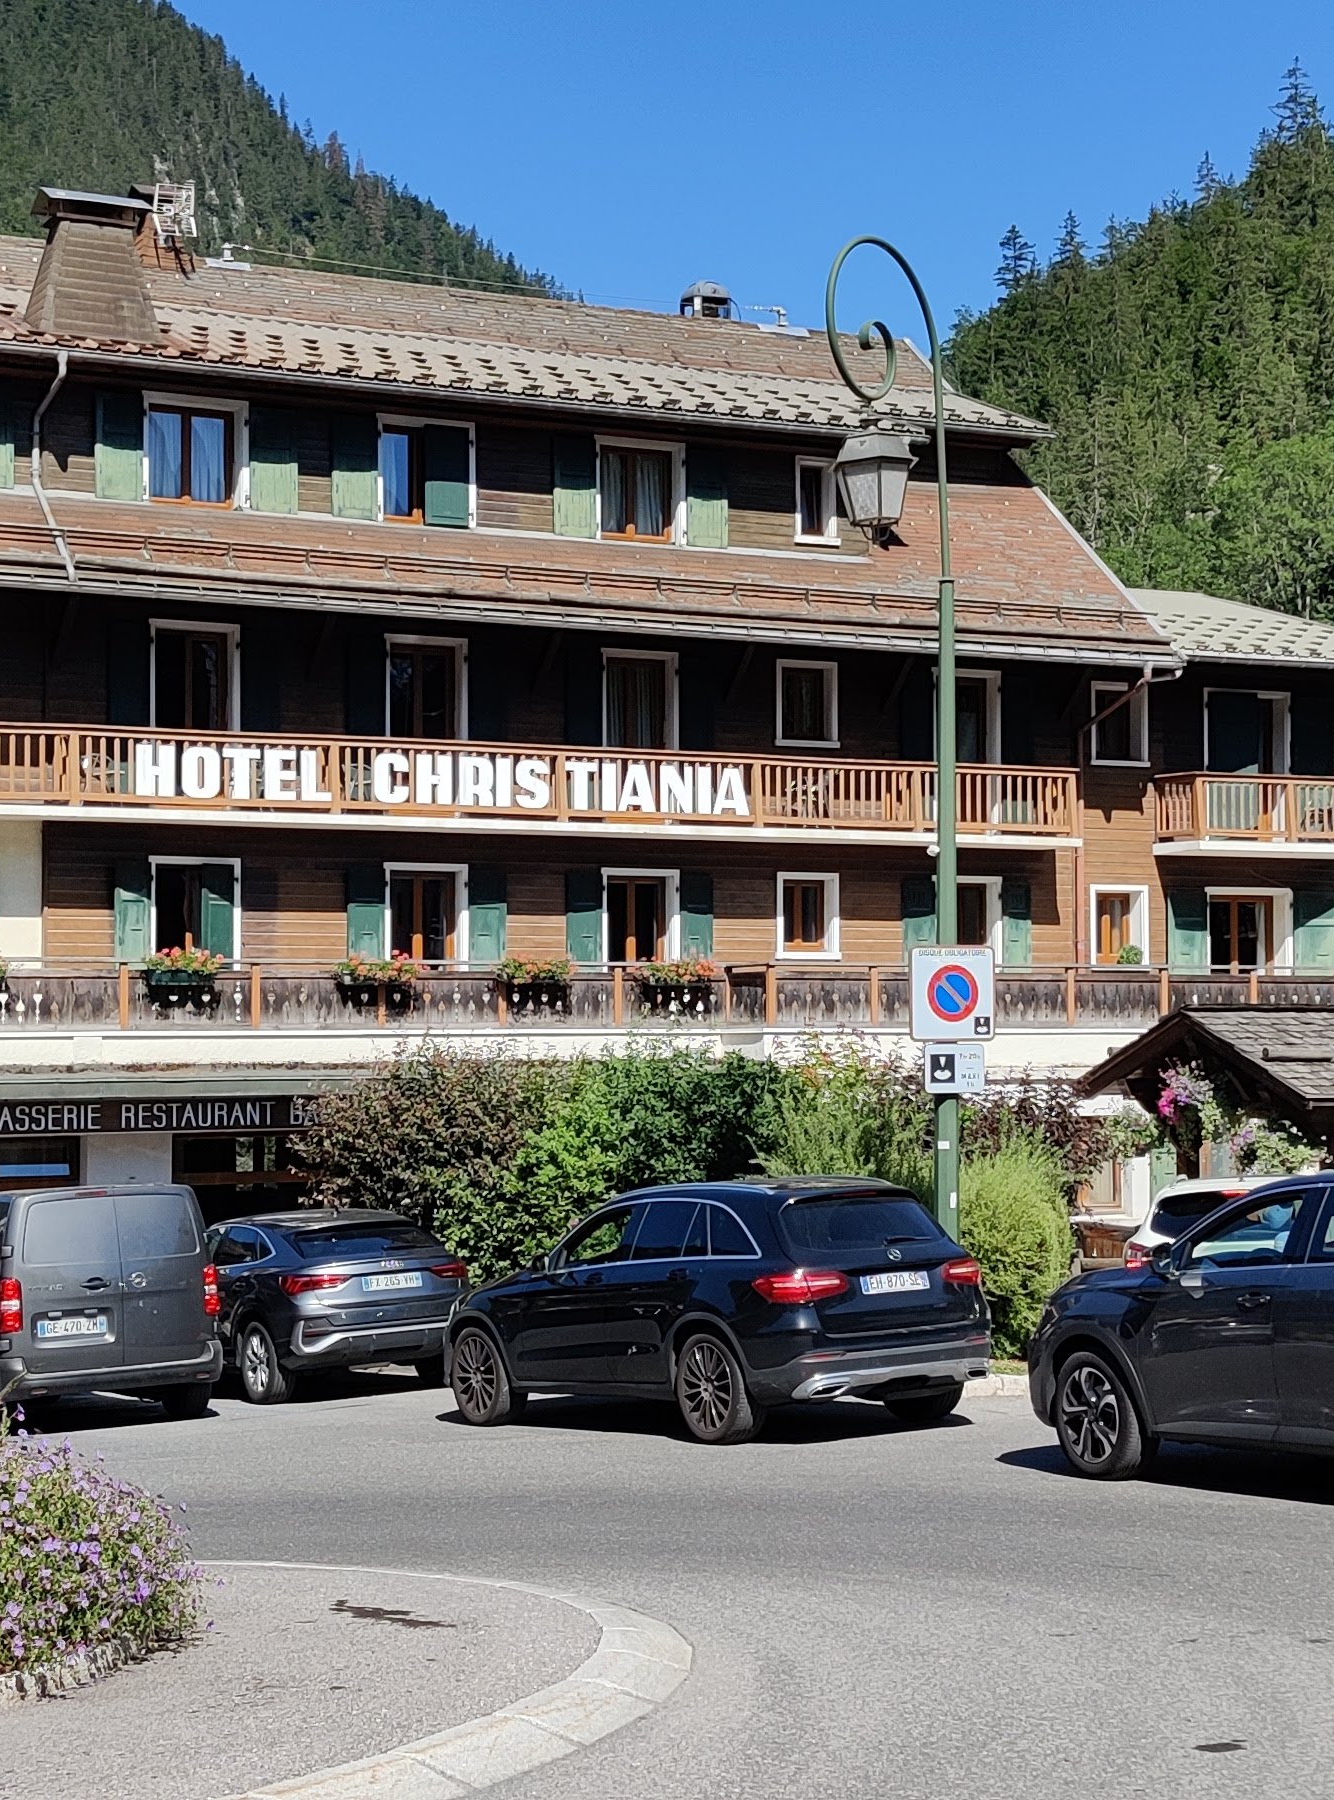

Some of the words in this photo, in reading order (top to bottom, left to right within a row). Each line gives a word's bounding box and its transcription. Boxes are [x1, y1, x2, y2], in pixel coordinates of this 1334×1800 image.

[134, 743, 332, 802] HOTEL
[120, 1101, 277, 1129] RESTAURANT
[289, 1099, 320, 1126] BA
